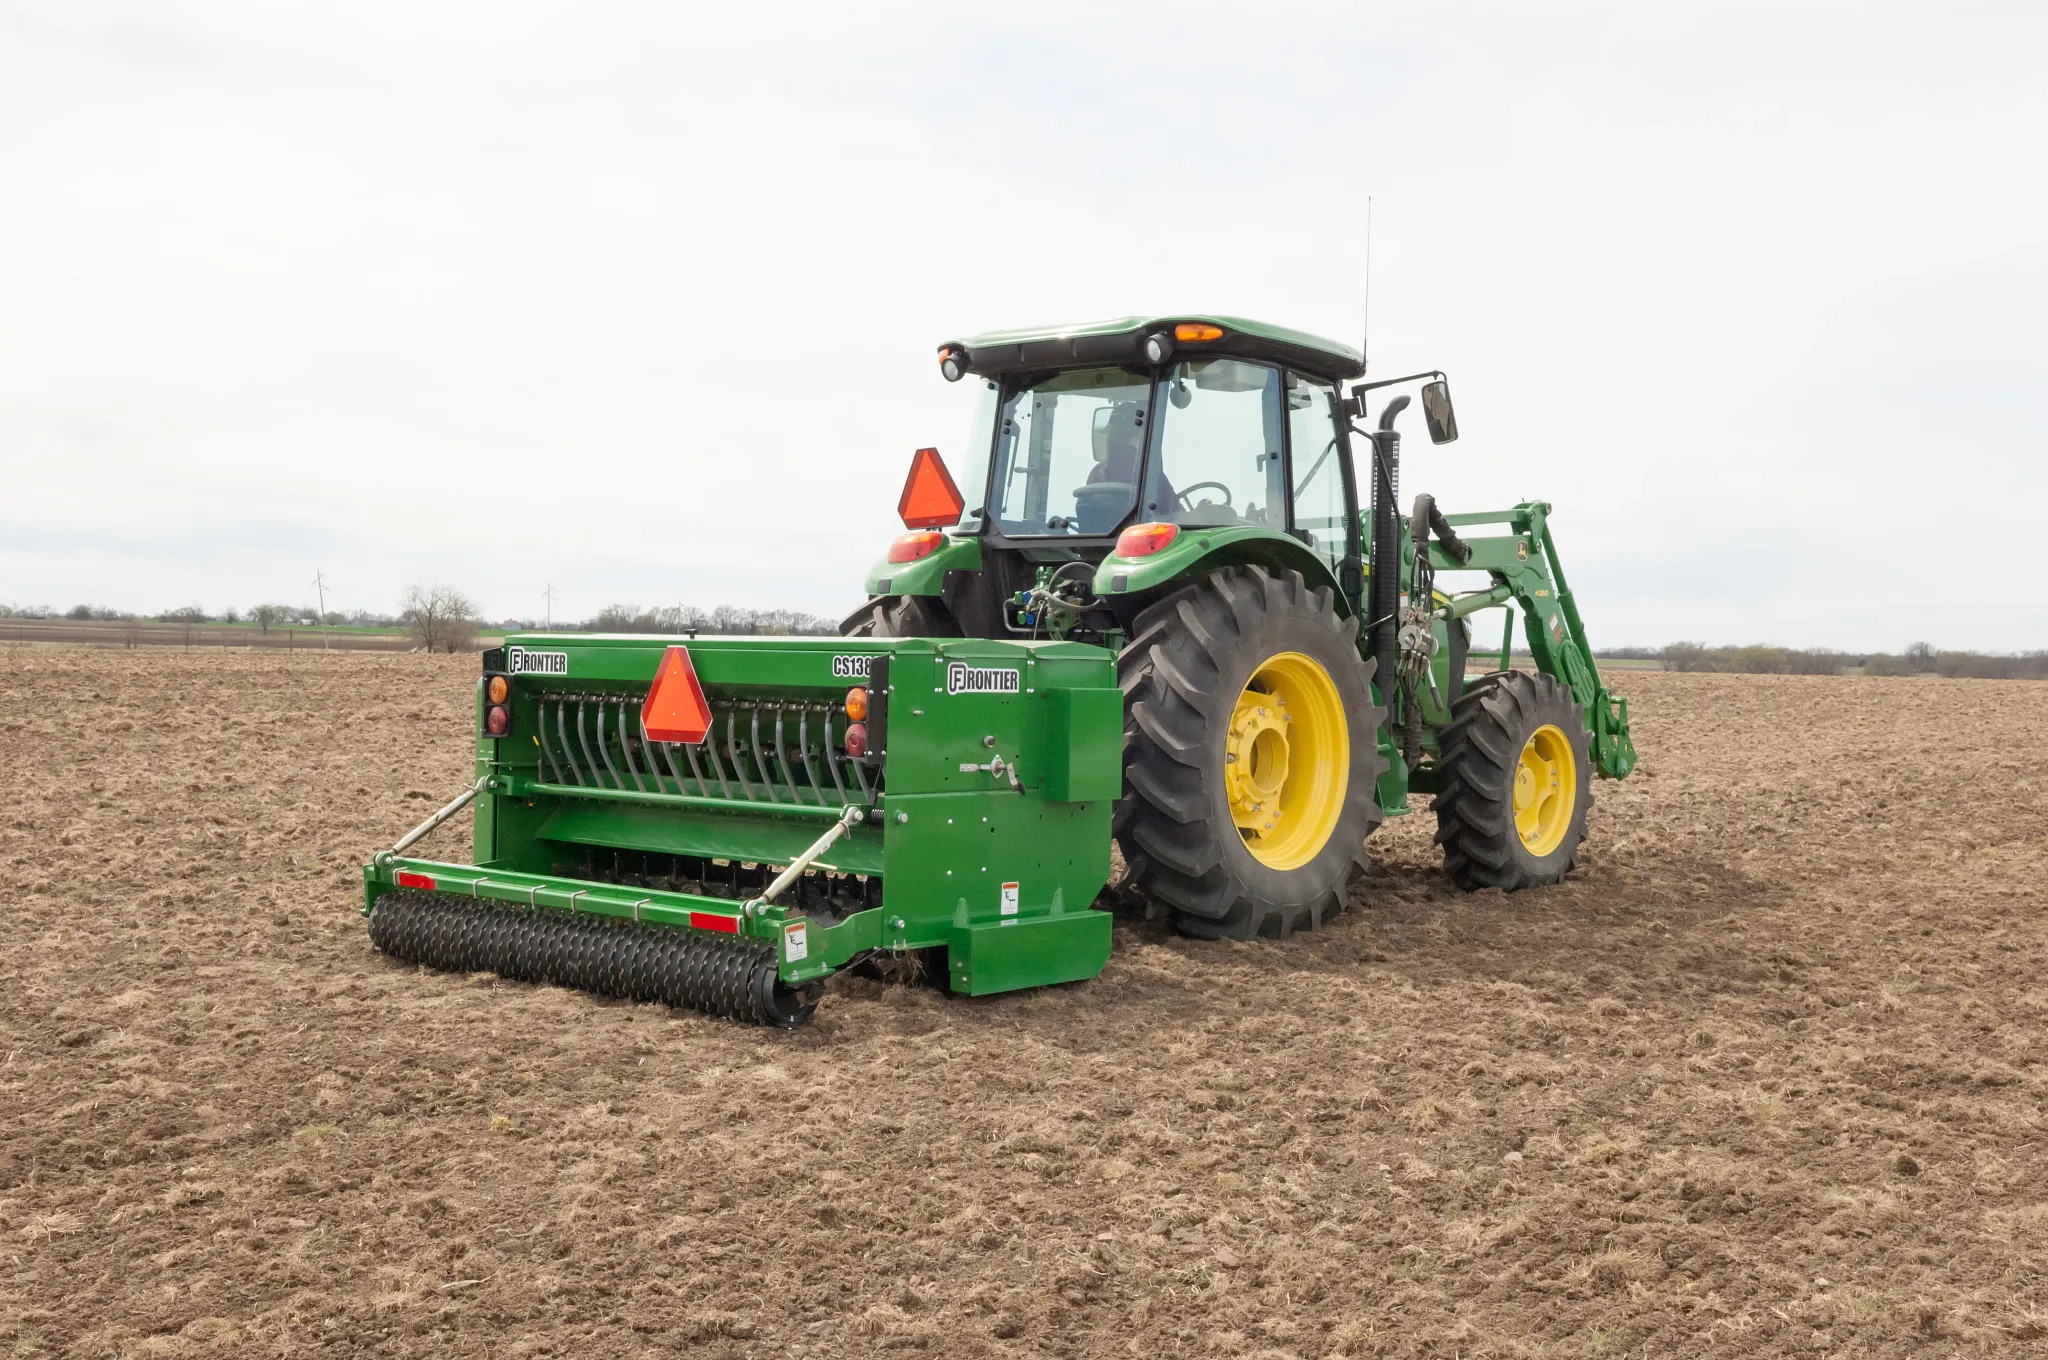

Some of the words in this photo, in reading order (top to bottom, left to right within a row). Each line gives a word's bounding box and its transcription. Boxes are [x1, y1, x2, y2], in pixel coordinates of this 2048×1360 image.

[509, 648, 566, 674] FRONTIER
[833, 656, 871, 676] CS138
[949, 663, 1018, 693] FRONTIER
